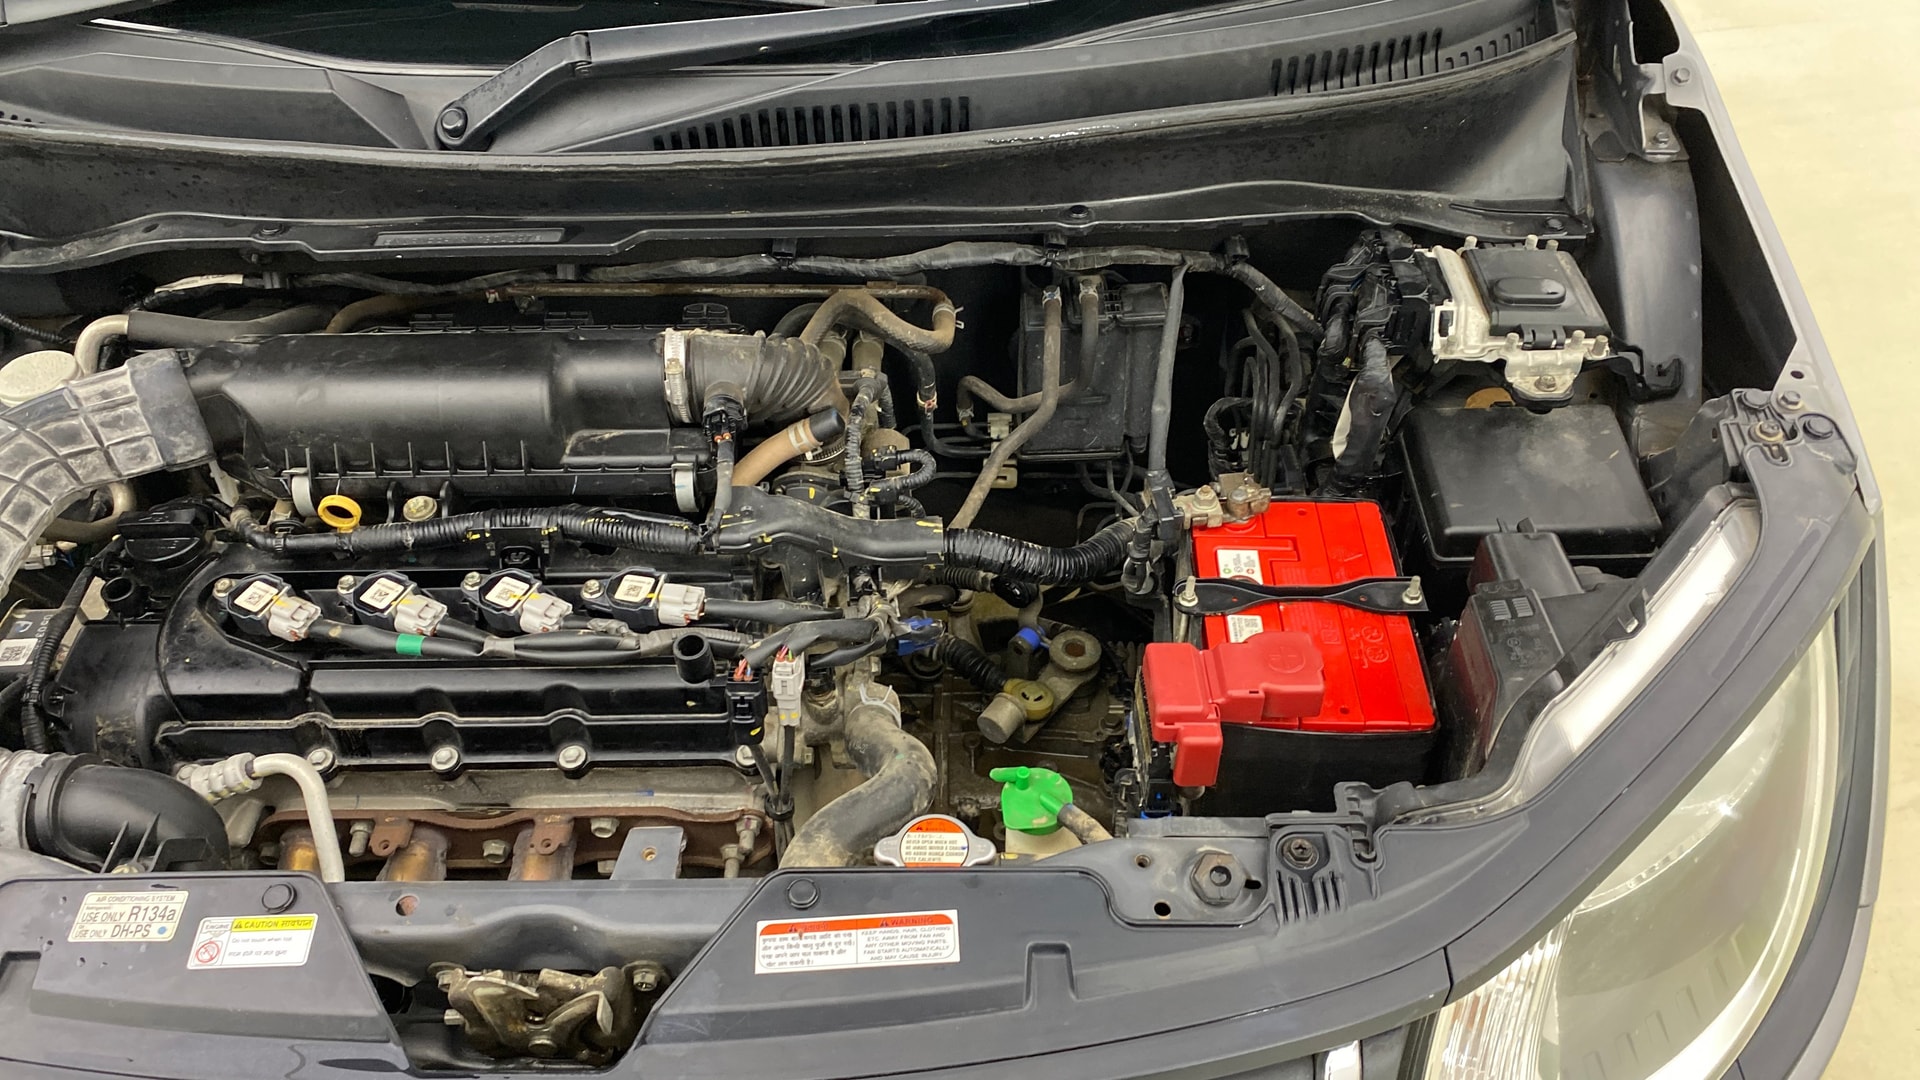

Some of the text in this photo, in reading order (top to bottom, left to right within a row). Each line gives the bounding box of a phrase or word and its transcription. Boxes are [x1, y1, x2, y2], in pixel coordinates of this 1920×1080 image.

[82, 905, 176, 922] USE ONLY R134a
[891, 917, 933, 926] WARNING
[75, 924, 151, 938] USE ONLY DH-PS
